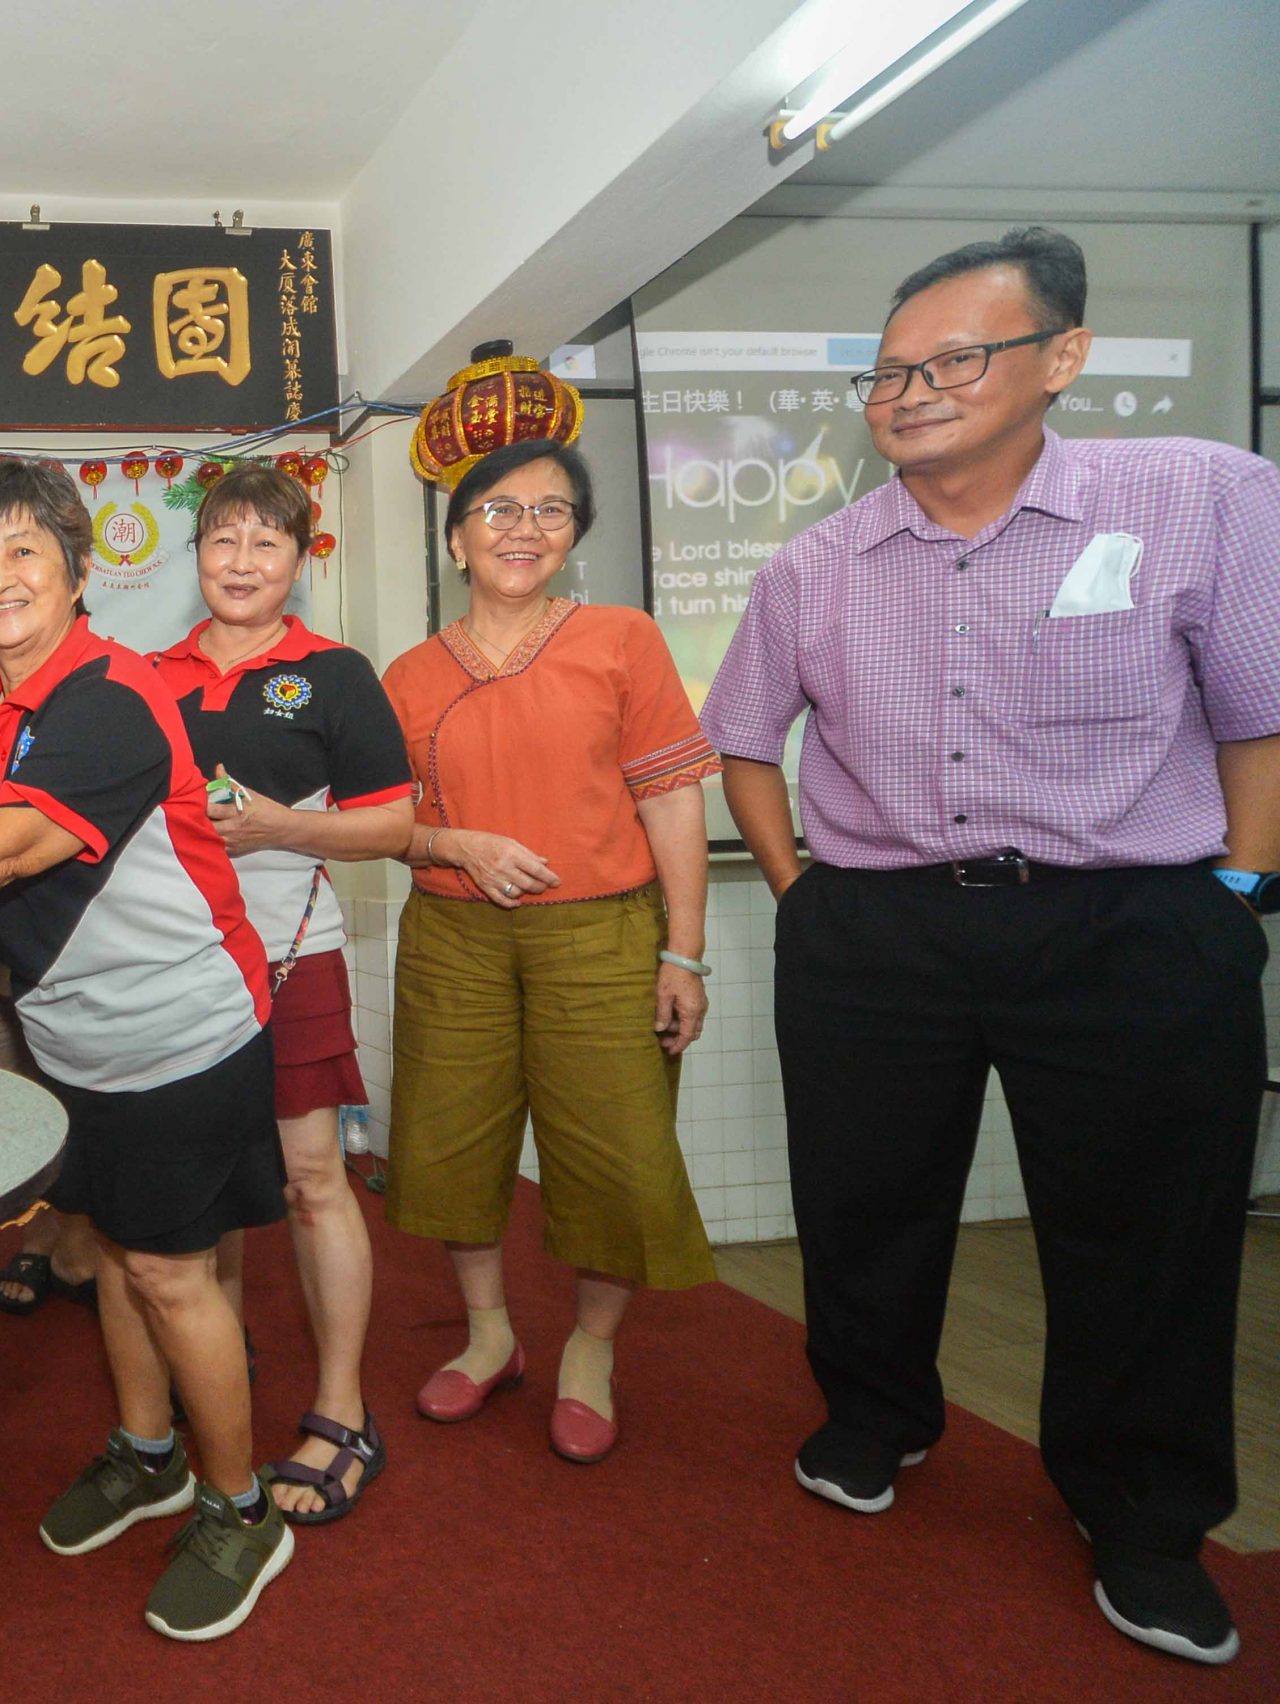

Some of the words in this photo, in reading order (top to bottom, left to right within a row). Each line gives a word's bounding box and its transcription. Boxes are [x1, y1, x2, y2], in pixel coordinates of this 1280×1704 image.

[299, 231, 318, 314] 廣東會館
[657, 346, 697, 357] Chrome
[113, 519, 137, 544] 潮
[671, 540, 720, 561] Lord
[671, 597, 716, 616] turn
